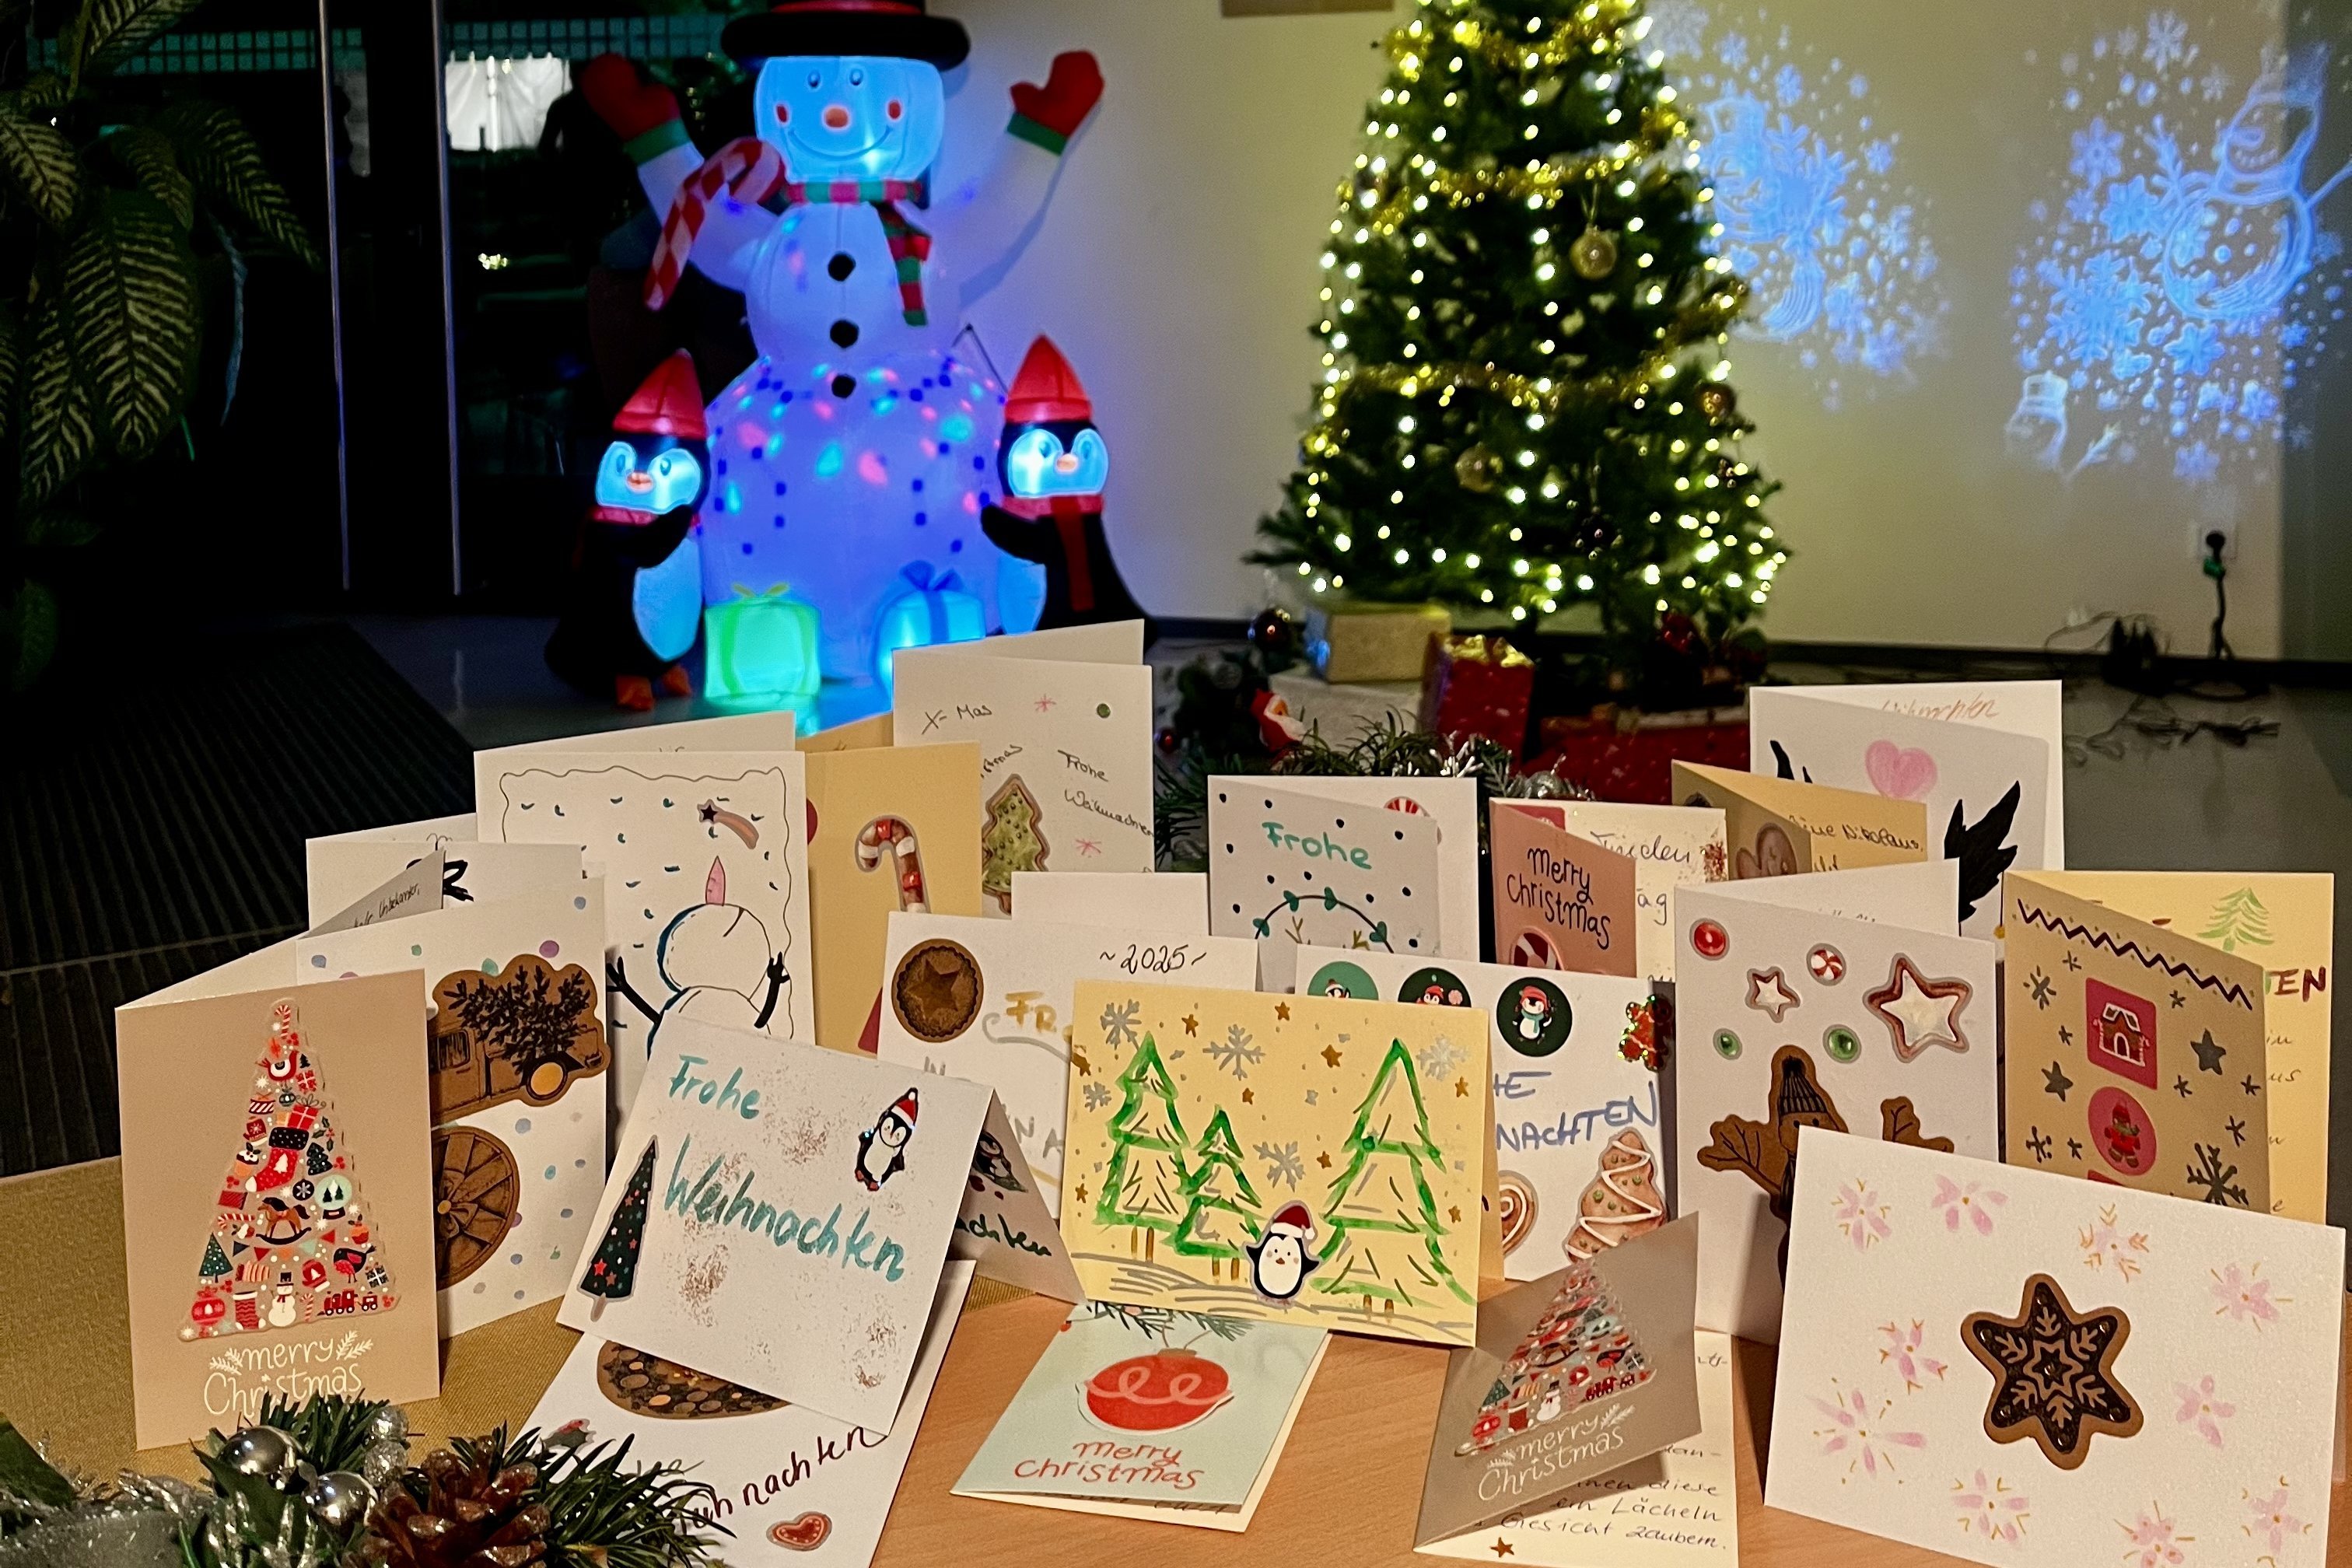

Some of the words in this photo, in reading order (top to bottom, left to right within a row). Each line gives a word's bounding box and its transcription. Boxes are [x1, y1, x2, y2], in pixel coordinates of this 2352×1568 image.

[1261, 821, 1374, 870] Frohe
[666, 1052, 761, 1121] Frohe
[663, 1132, 906, 1283] Weihnachten
[242, 1337, 334, 1370] merry
[1517, 1415, 1600, 1461] merry
[1478, 1426, 1625, 1502] Christmas
[1612, 1496, 1723, 1522] Lächeln
